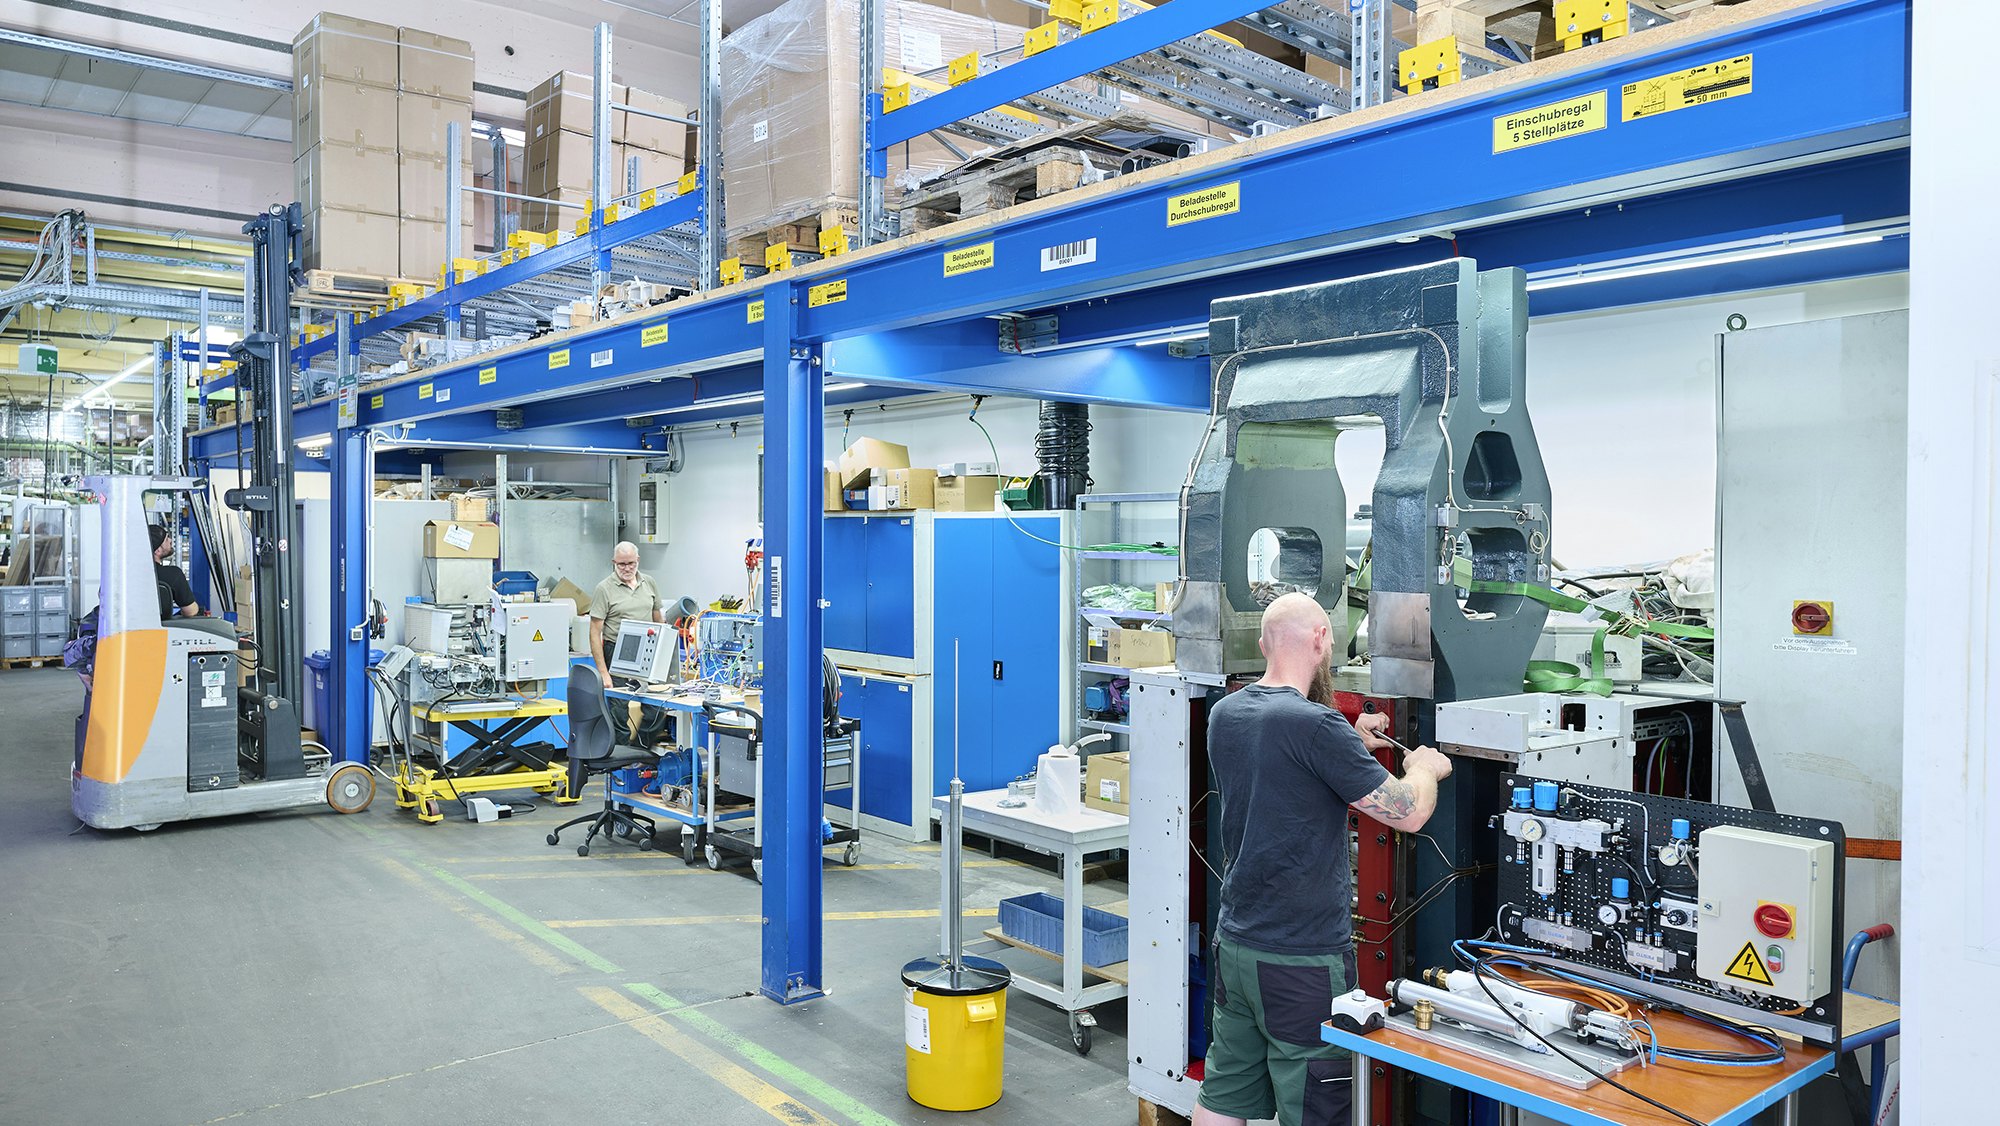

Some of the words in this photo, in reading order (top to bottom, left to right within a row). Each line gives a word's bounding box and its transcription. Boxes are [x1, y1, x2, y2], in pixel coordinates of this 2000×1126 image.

[1696, 96, 1708, 104] 50
[1710, 91, 1728, 100] mm
[1506, 100, 1592, 131] Einschubregal
[1513, 132, 1520, 143] 5
[1523, 118, 1585, 141] Stellplätze
[1179, 190, 1227, 208] Beladestelle
[1170, 199, 1236, 221] Durchschubregal
[952, 248, 985, 262] Beladestelle
[945, 256, 992, 273] Durchschubregal
[1787, 645, 1809, 653] Display
